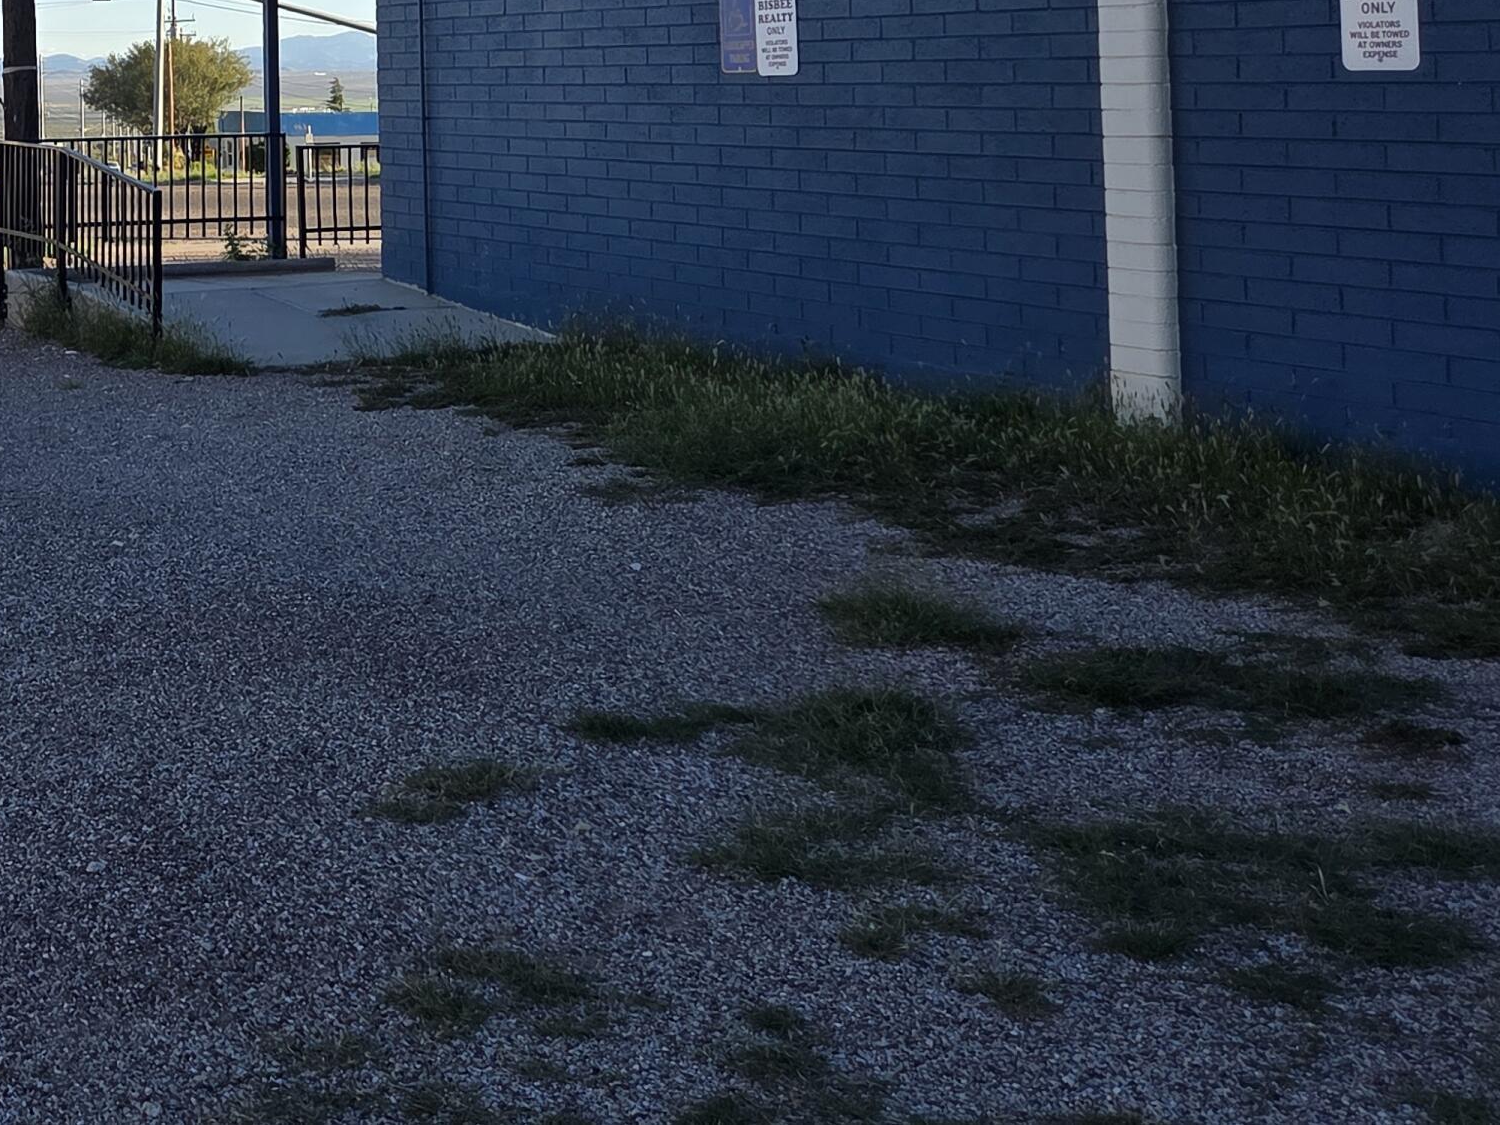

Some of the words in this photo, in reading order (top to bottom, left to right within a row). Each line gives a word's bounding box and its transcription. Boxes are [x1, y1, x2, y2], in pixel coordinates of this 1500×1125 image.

[1361, 1, 1396, 14] ONLY
[758, 12, 793, 24] REALTY
[1357, 20, 1401, 29] VIOLATORS
[766, 26, 785, 35] ONLY
[1349, 31, 1369, 39] WILL
[1370, 31, 1380, 39] BE
[1381, 30, 1410, 39] TOWED
[1357, 41, 1368, 49] AT
